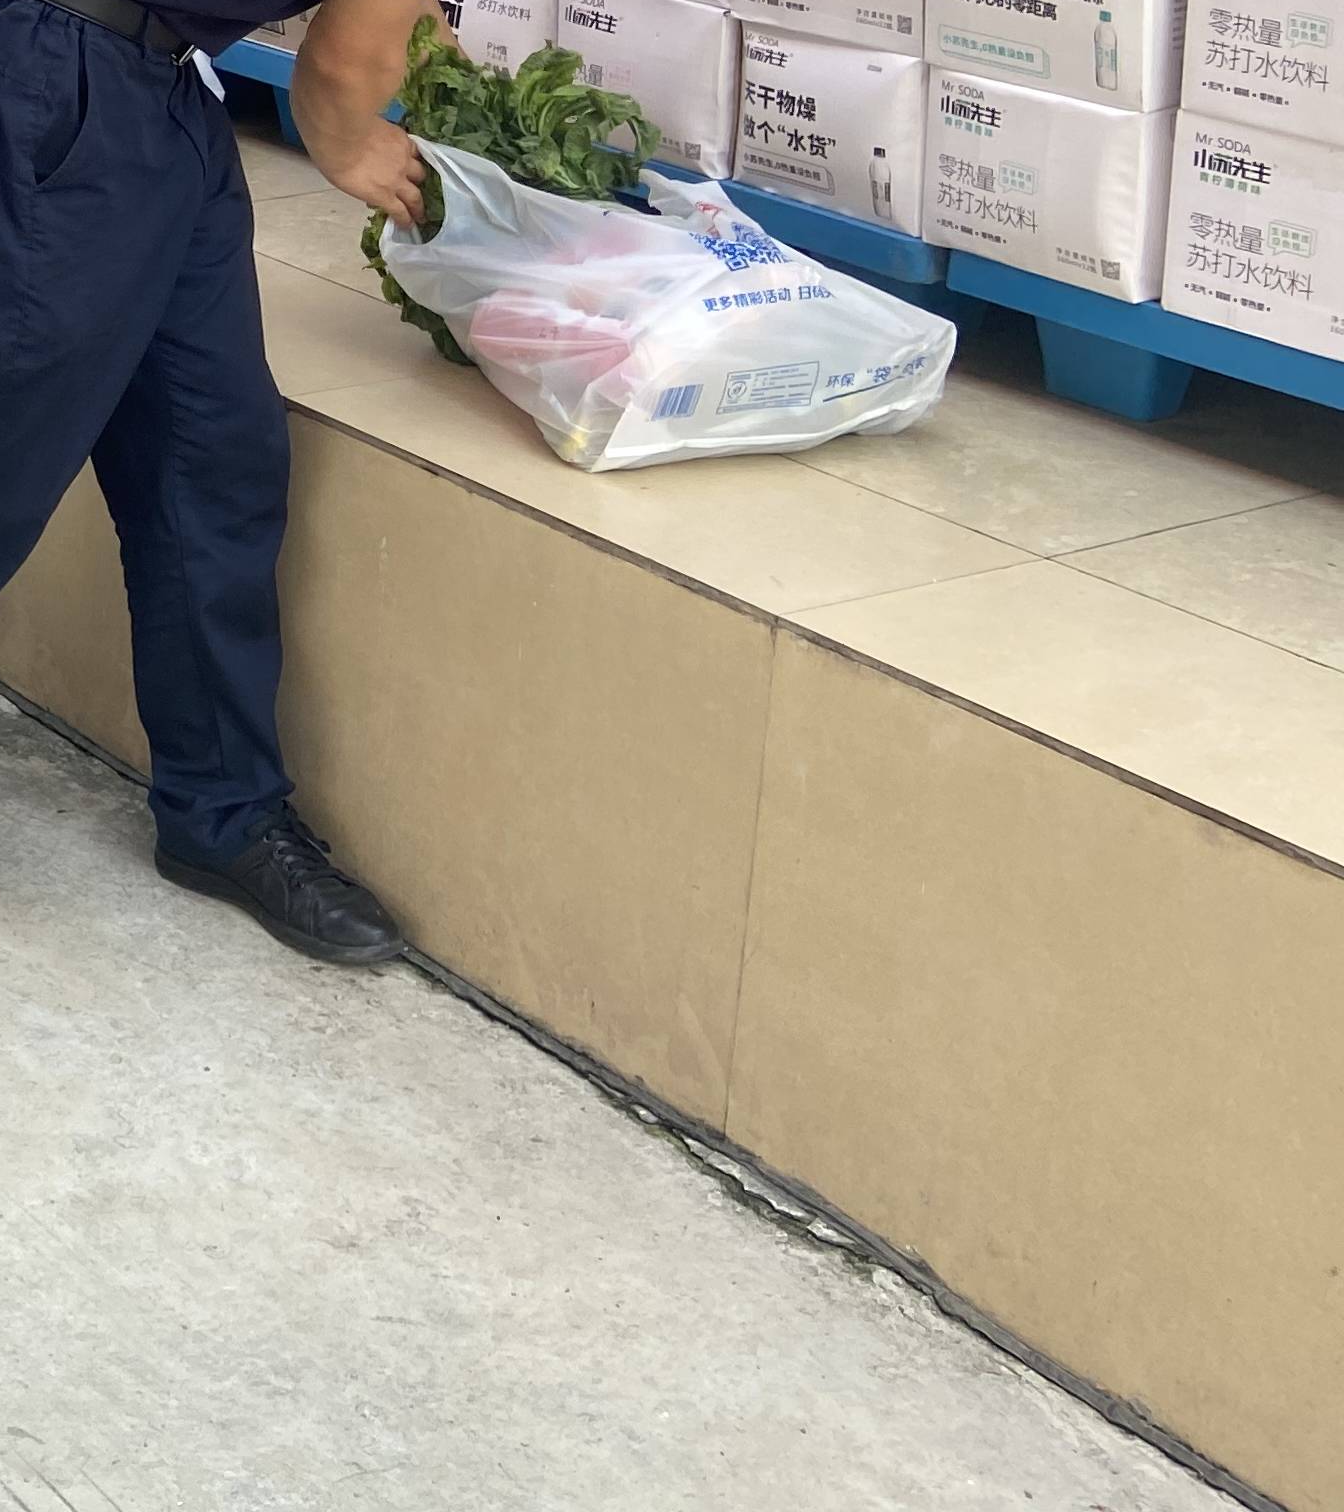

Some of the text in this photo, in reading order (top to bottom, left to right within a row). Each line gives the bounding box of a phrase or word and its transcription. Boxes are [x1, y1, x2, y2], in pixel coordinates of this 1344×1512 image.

[565, 5, 617, 34] 小苏先生
[1209, 8, 1283, 48] 零热量
[487, 42, 507, 56] PH值
[757, 35, 779, 47] SODA
[1205, 40, 1329, 92] 苏打水饮料
[745, 80, 816, 121] 天干物燥
[942, 80, 984, 100] Mr SODA
[940, 95, 1002, 128] 小苏先生
[1217, 137, 1251, 154] SODA
[938, 154, 996, 194] 零热量
[1194, 149, 1271, 184] 小苏先生
[937, 182, 1038, 234] 苏打水饮料
[1189, 212, 1264, 255] 零热量
[1187, 242, 1314, 301] 苏打水饮料
[703, 289, 791, 312] 更多精彩活动
[826, 373, 855, 388] 环保
